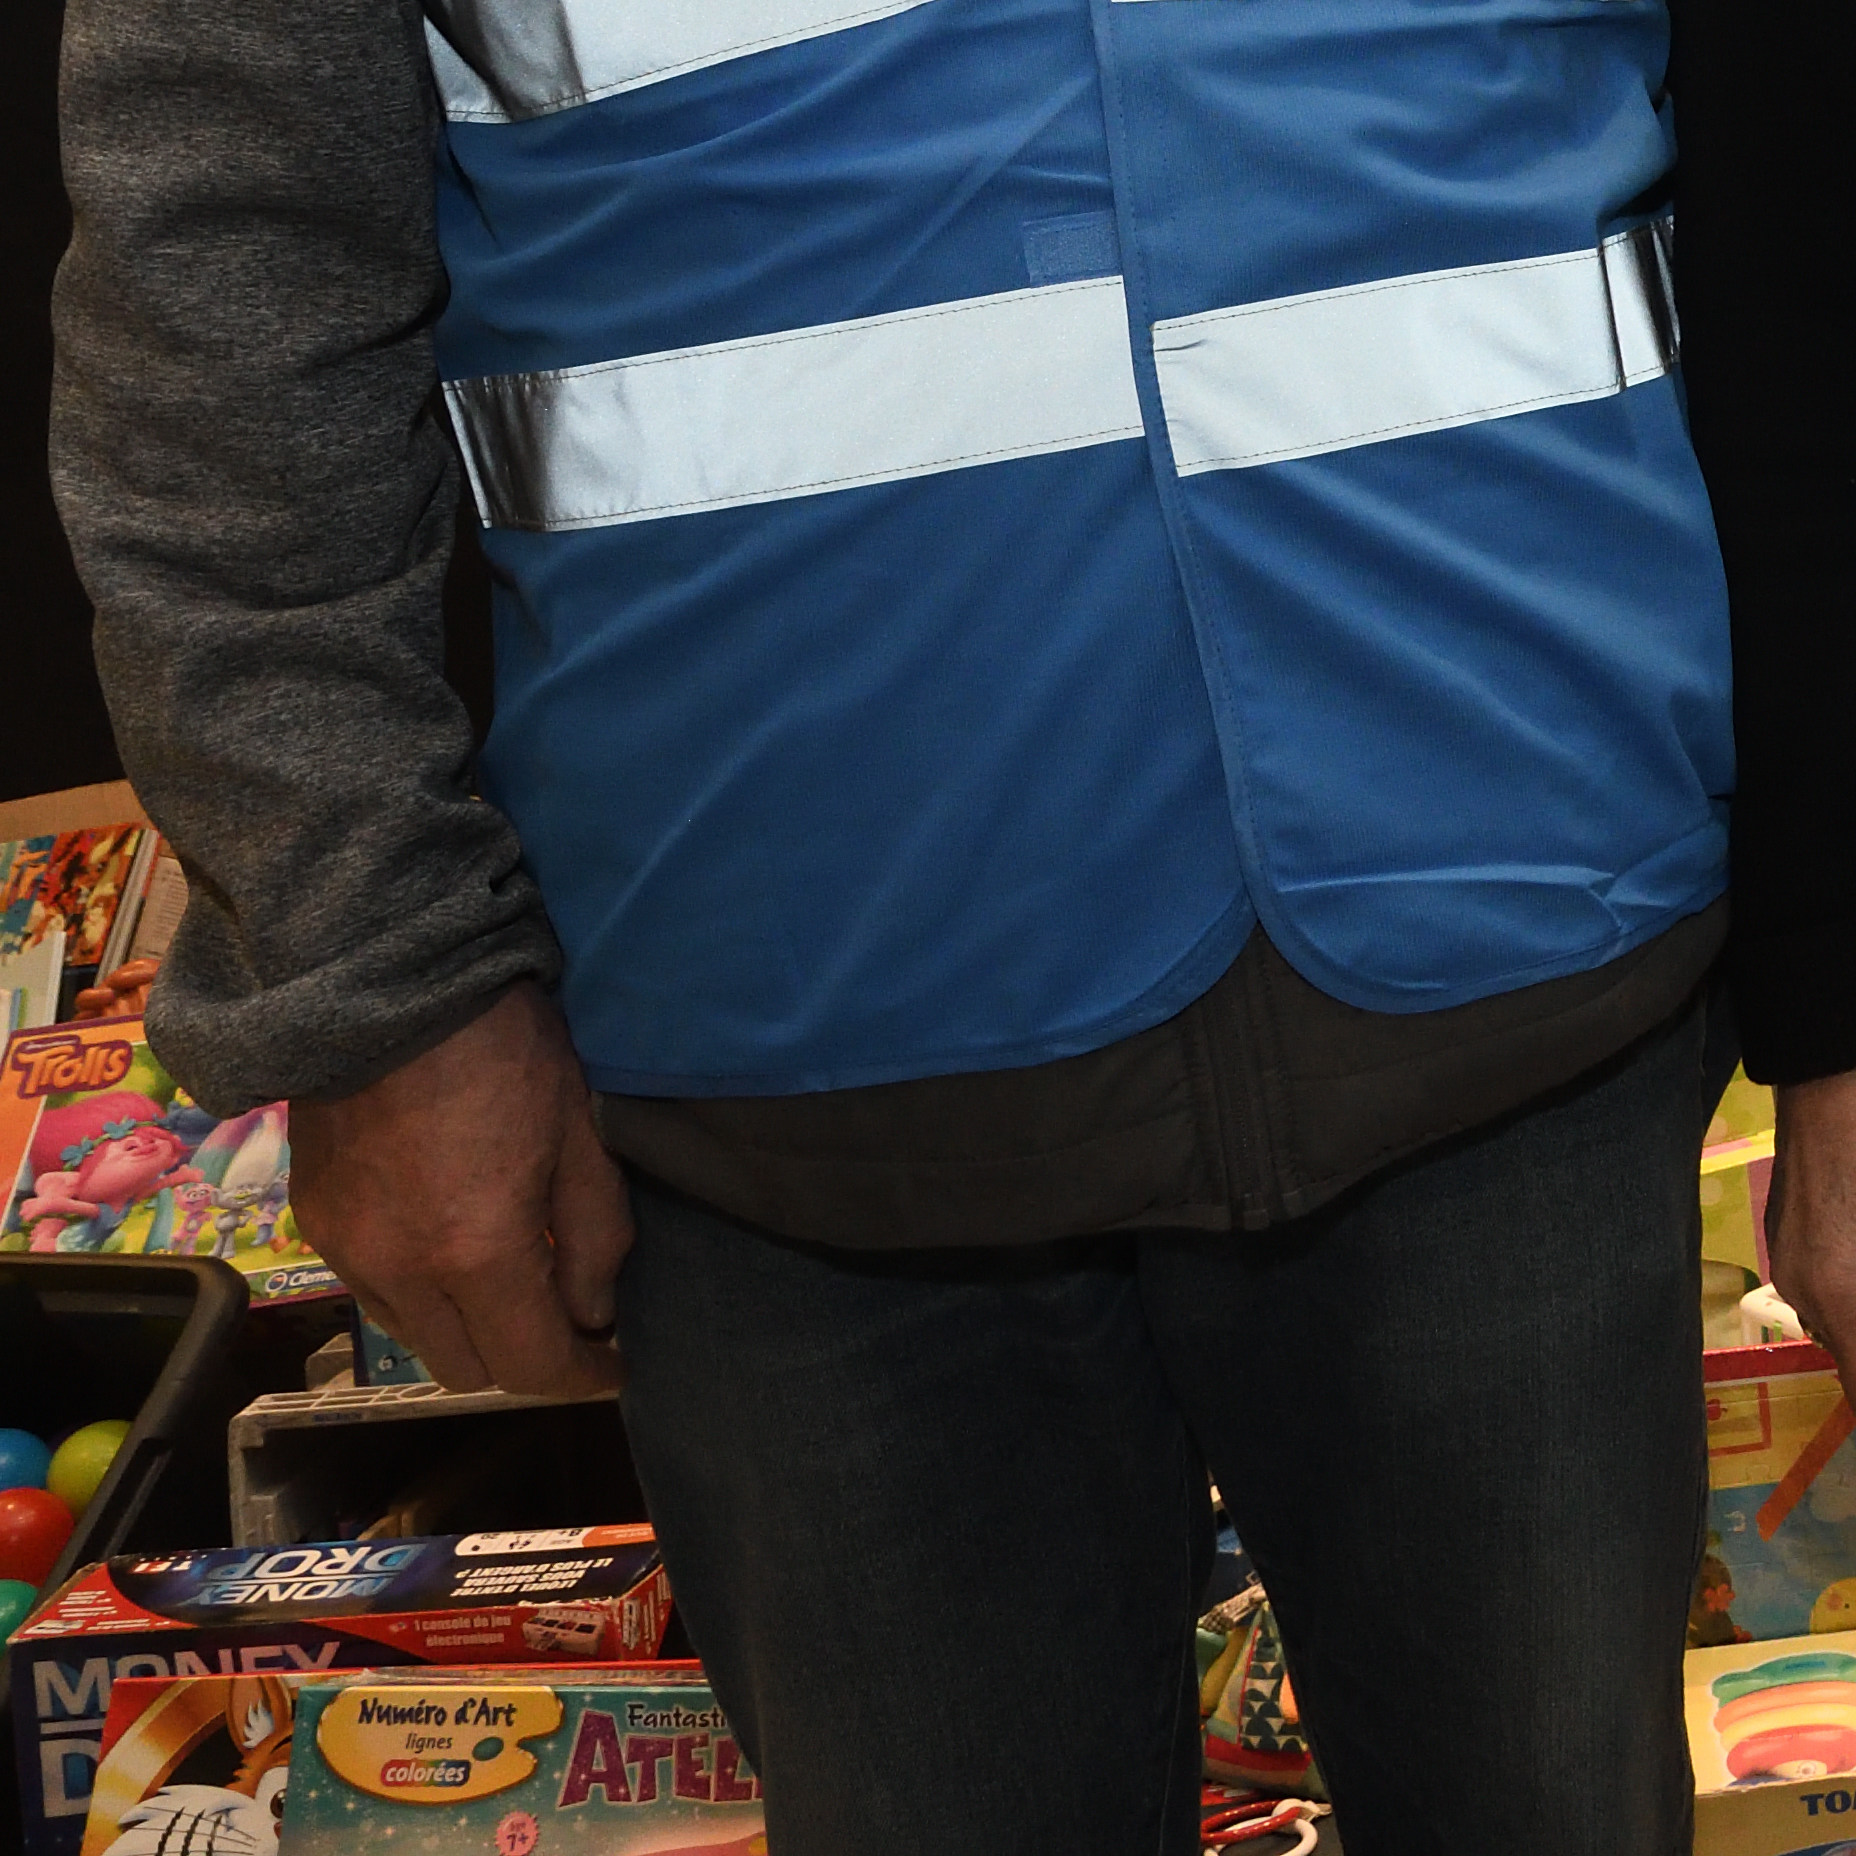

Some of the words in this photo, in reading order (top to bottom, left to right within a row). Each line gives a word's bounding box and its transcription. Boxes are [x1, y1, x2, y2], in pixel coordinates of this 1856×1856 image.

[15, 1041, 129, 1094] Trolls
[207, 1543, 426, 1582] DROP
[194, 1573, 396, 1606] MONEY
[358, 1697, 446, 1727] Numéro
[454, 1696, 517, 1727] d'Art
[627, 1702, 726, 1730] Fantasti
[405, 1732, 452, 1752] lignes
[385, 1760, 466, 1786] colorées
[505, 1831, 528, 1850] 7+
